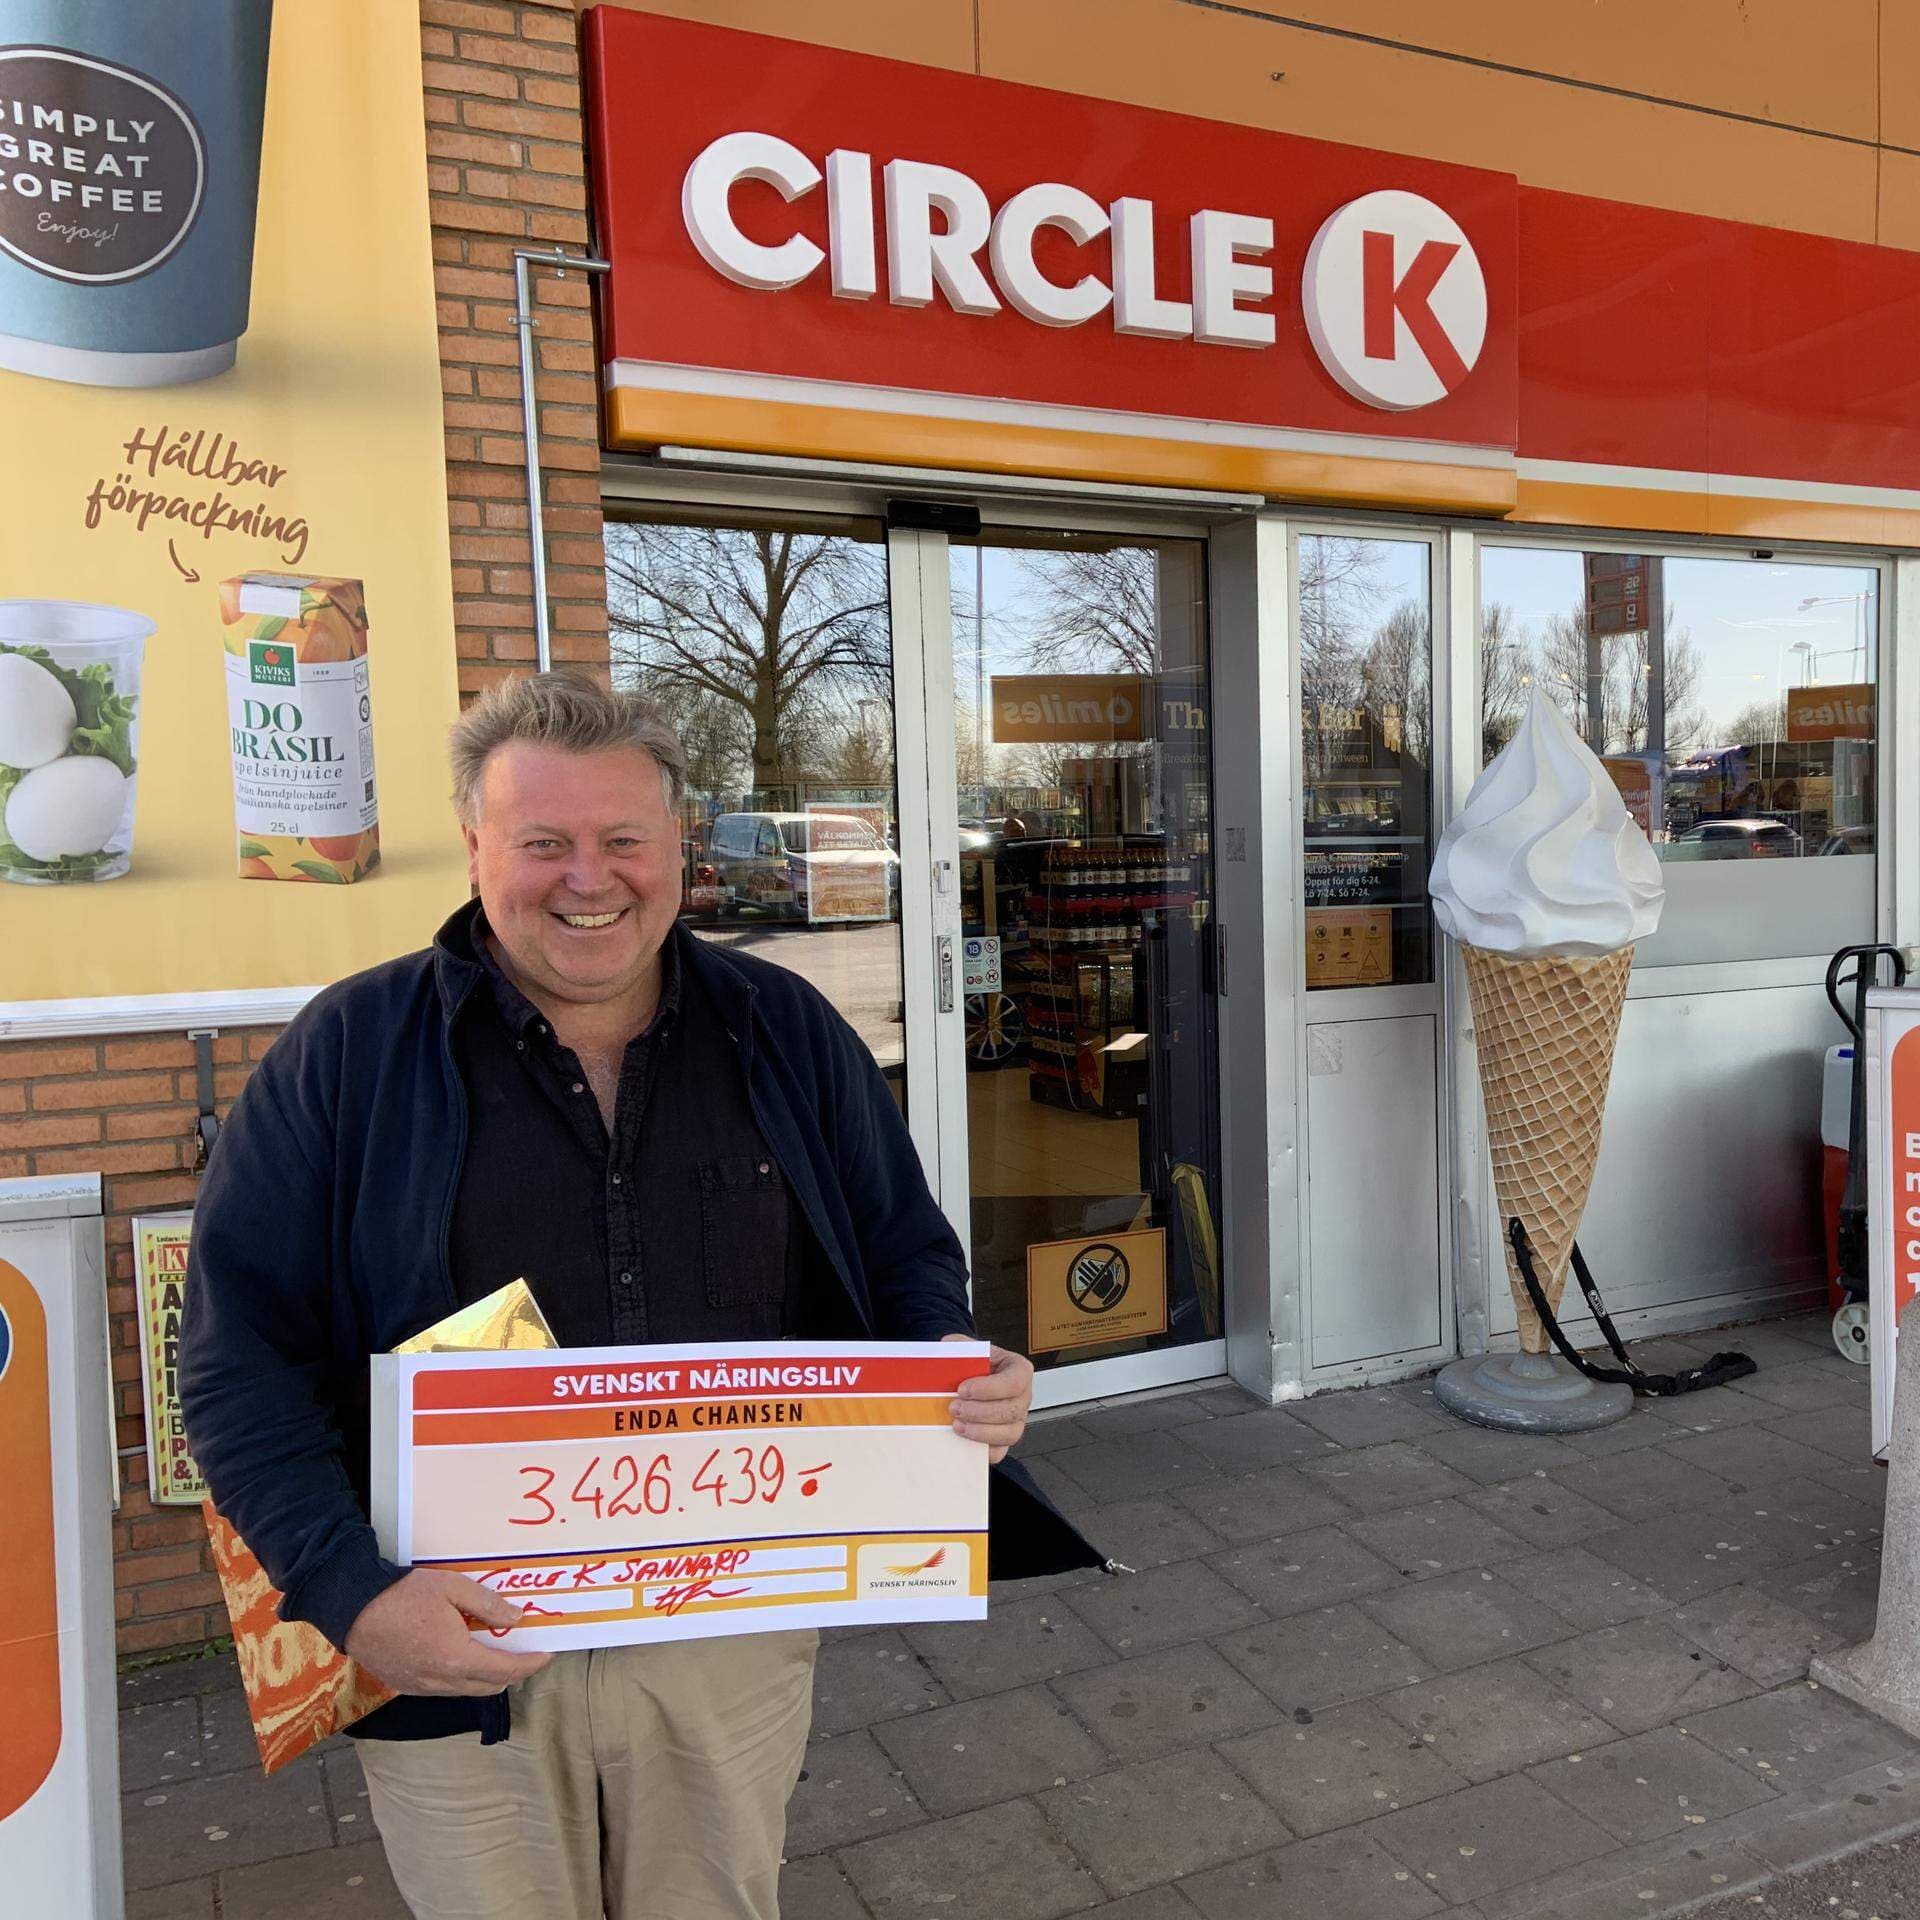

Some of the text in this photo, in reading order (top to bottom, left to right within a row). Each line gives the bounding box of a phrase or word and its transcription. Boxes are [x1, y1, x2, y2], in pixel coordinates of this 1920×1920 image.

[0, 98, 155, 143] IMPLY
[0, 169, 163, 213] OFFEE
[37, 211, 119, 247] Enjoy!
[682, 131, 1472, 394] CIRCLE K
[123, 425, 287, 488] Hållbar
[85, 473, 309, 565] förpackning
[254, 665, 291, 677] KIVIKS
[243, 699, 303, 733] DO
[1163, 701, 1206, 729] Th
[257, 787, 337, 800] handplockade
[294, 801, 348, 812] apelsiner
[270, 821, 299, 834] 25 cl
[1332, 876, 1345, 885] för
[1346, 876, 1360, 887] dig
[553, 1363, 863, 1398] SVENSKT NÄRINGSLIV
[614, 1402, 804, 1432] ENDA CHANSEN
[573, 1560, 607, 1589] K
[612, 1549, 751, 1583] SANNARP
[869, 1580, 906, 1589] SVENSKT
